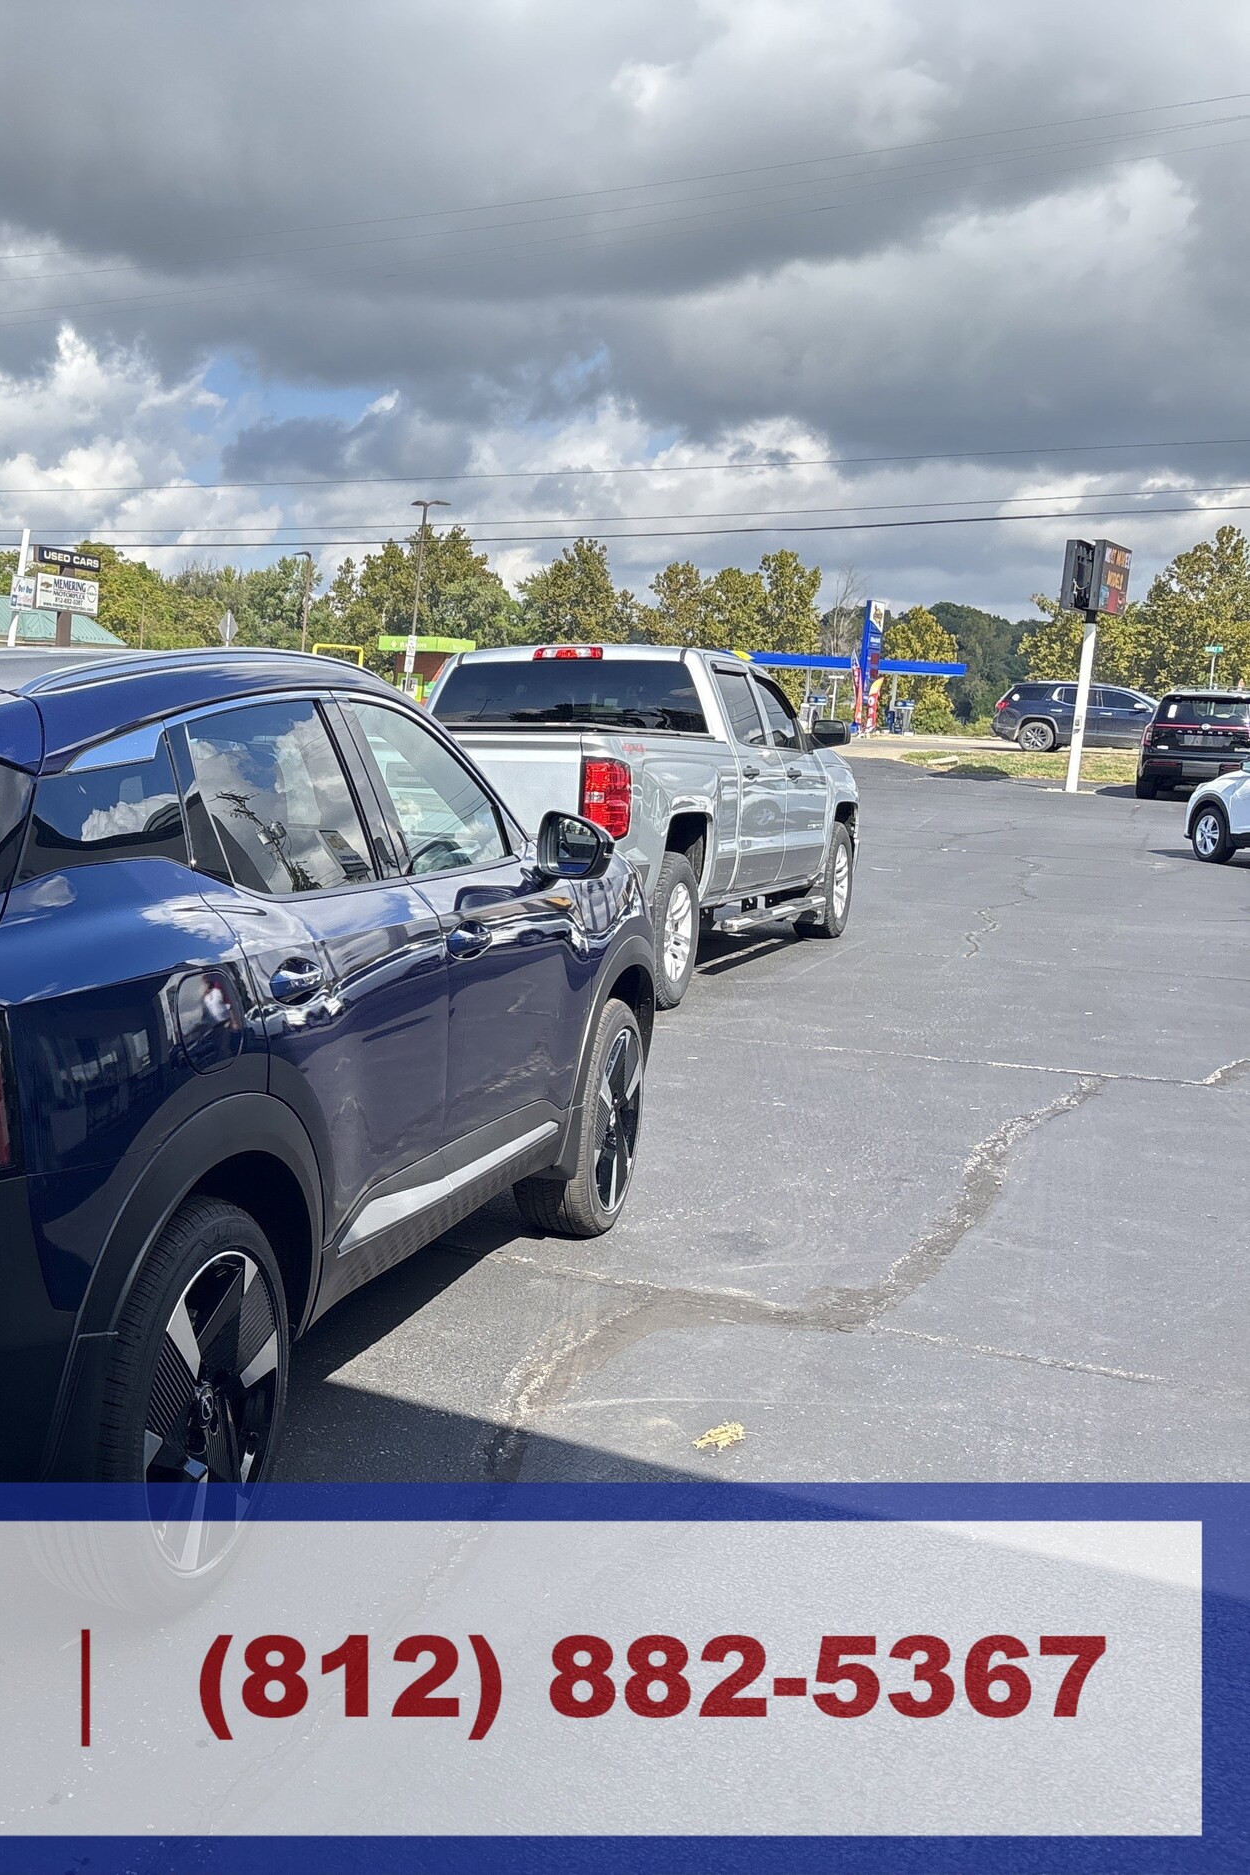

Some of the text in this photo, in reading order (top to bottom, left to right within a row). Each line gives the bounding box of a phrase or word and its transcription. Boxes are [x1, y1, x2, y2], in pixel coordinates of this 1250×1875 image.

[43, 550, 99, 568] USED CARS
[53, 578, 86, 593] MEMERING
